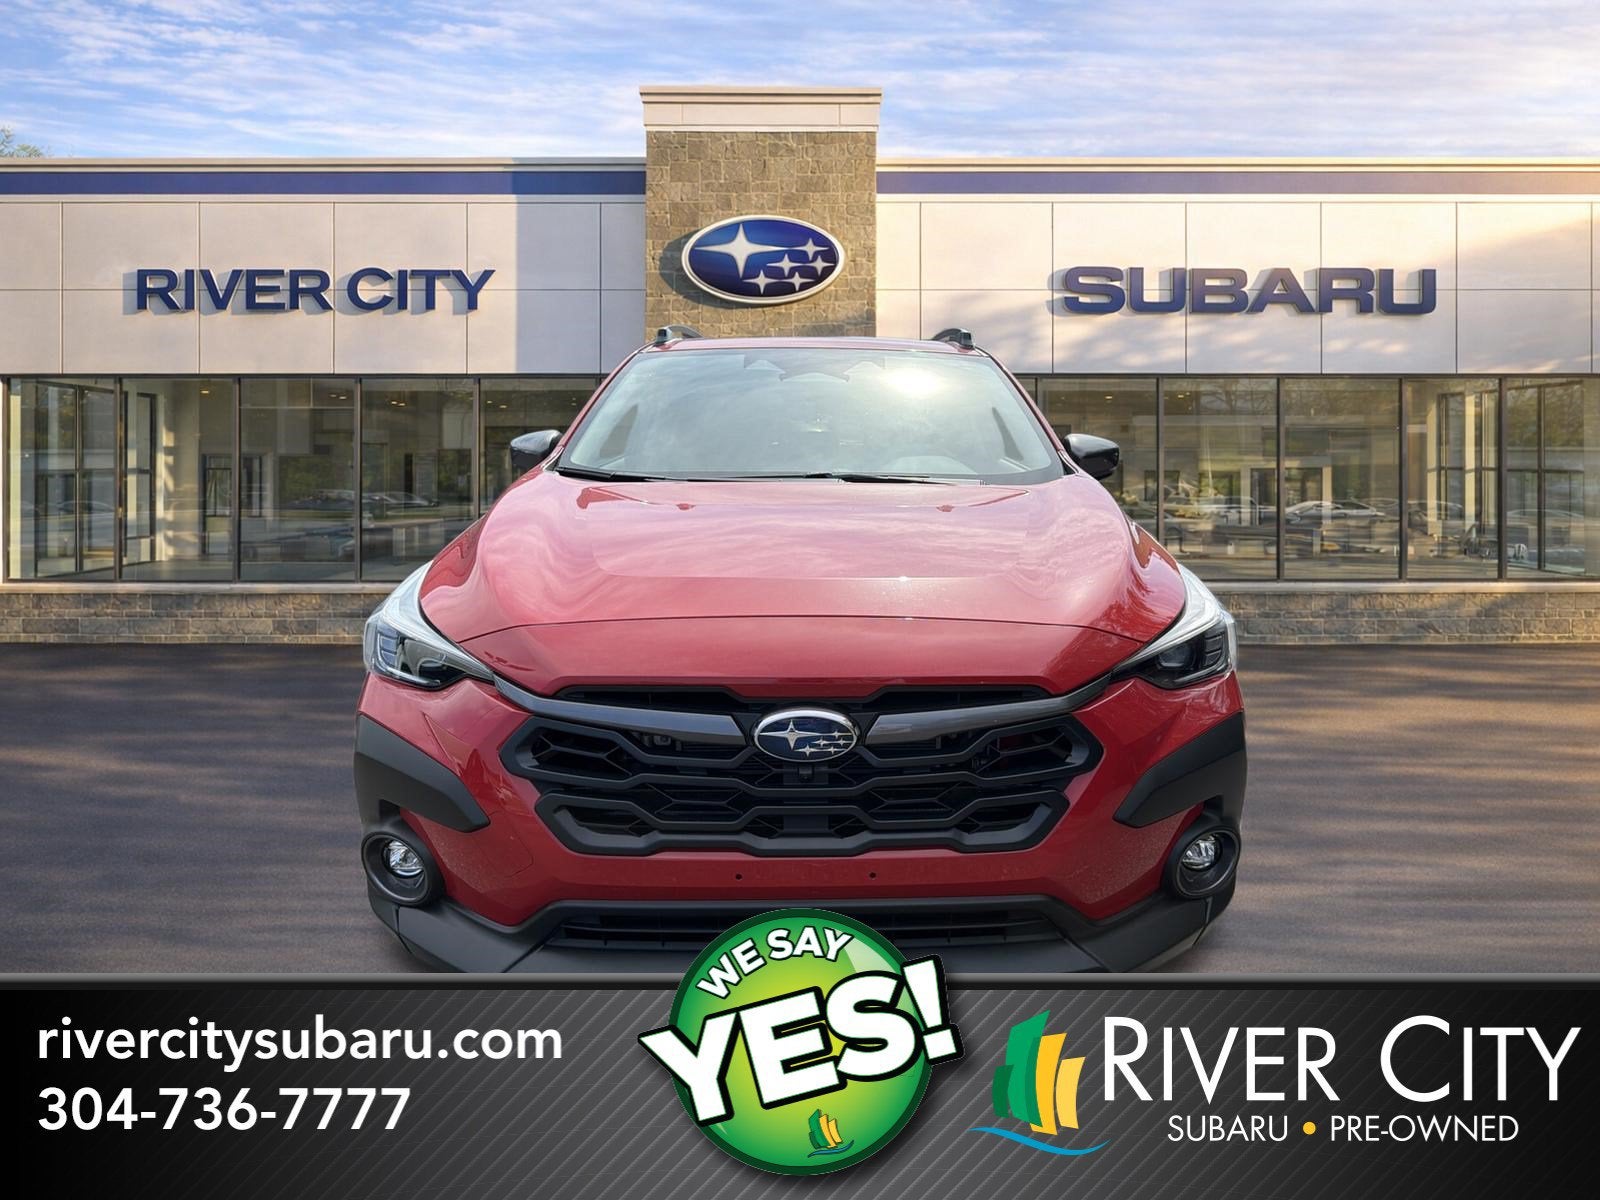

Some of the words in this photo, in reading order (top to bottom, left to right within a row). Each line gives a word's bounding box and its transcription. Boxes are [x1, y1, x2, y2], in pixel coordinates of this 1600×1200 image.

[136, 268, 334, 312] RIVER
[347, 267, 496, 312] CITY
[1062, 266, 1437, 315] SUBARU
